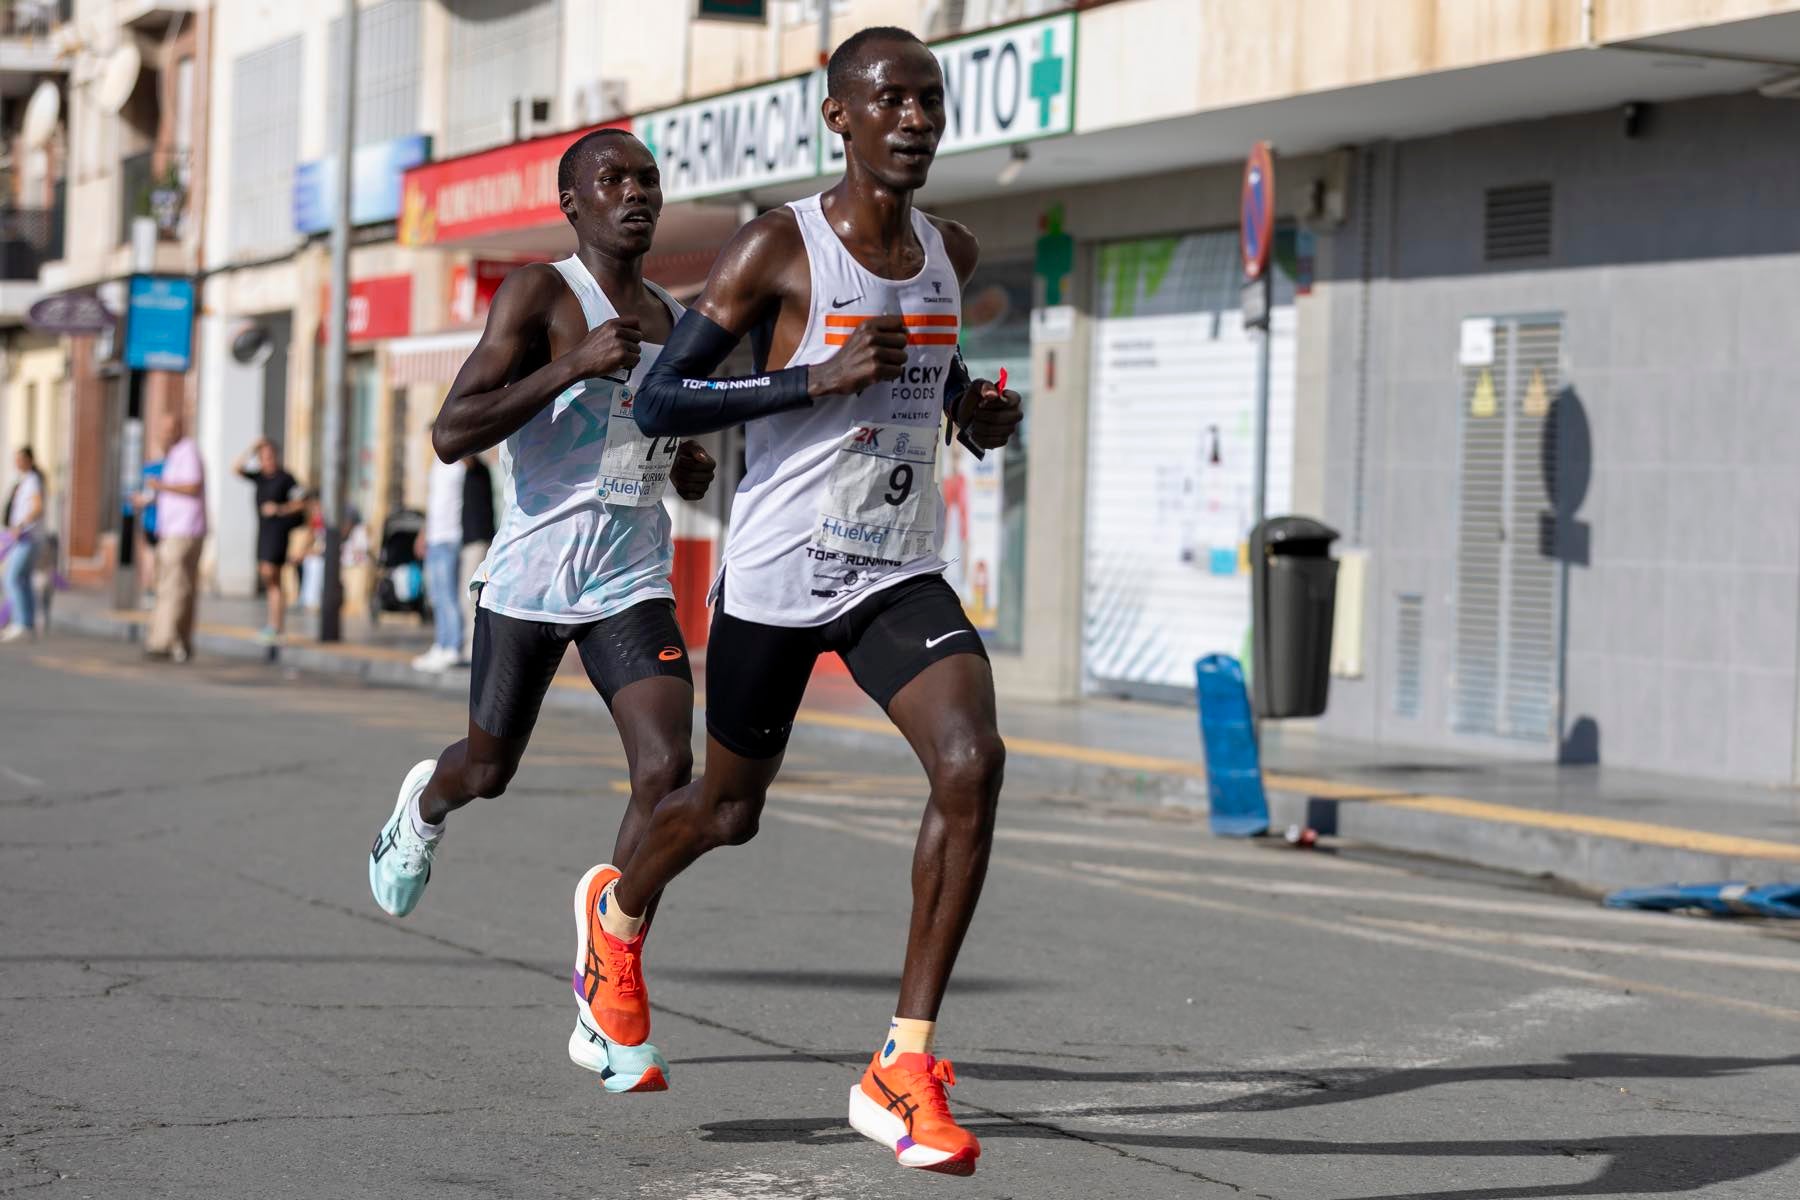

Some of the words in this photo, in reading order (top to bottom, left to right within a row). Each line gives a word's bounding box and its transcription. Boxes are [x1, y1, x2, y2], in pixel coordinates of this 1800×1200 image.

[664, 74, 817, 190] FARMACIA
[943, 39, 1022, 138] NTO
[891, 365, 943, 384] ICKY
[891, 387, 936, 400] FOODS
[891, 411, 931, 420] ATHLETIC
[854, 427, 885, 447] 2K
[645, 436, 678, 461] 74
[602, 477, 651, 496] Huelva
[884, 463, 914, 506] 9
[822, 517, 884, 545] Huelva
